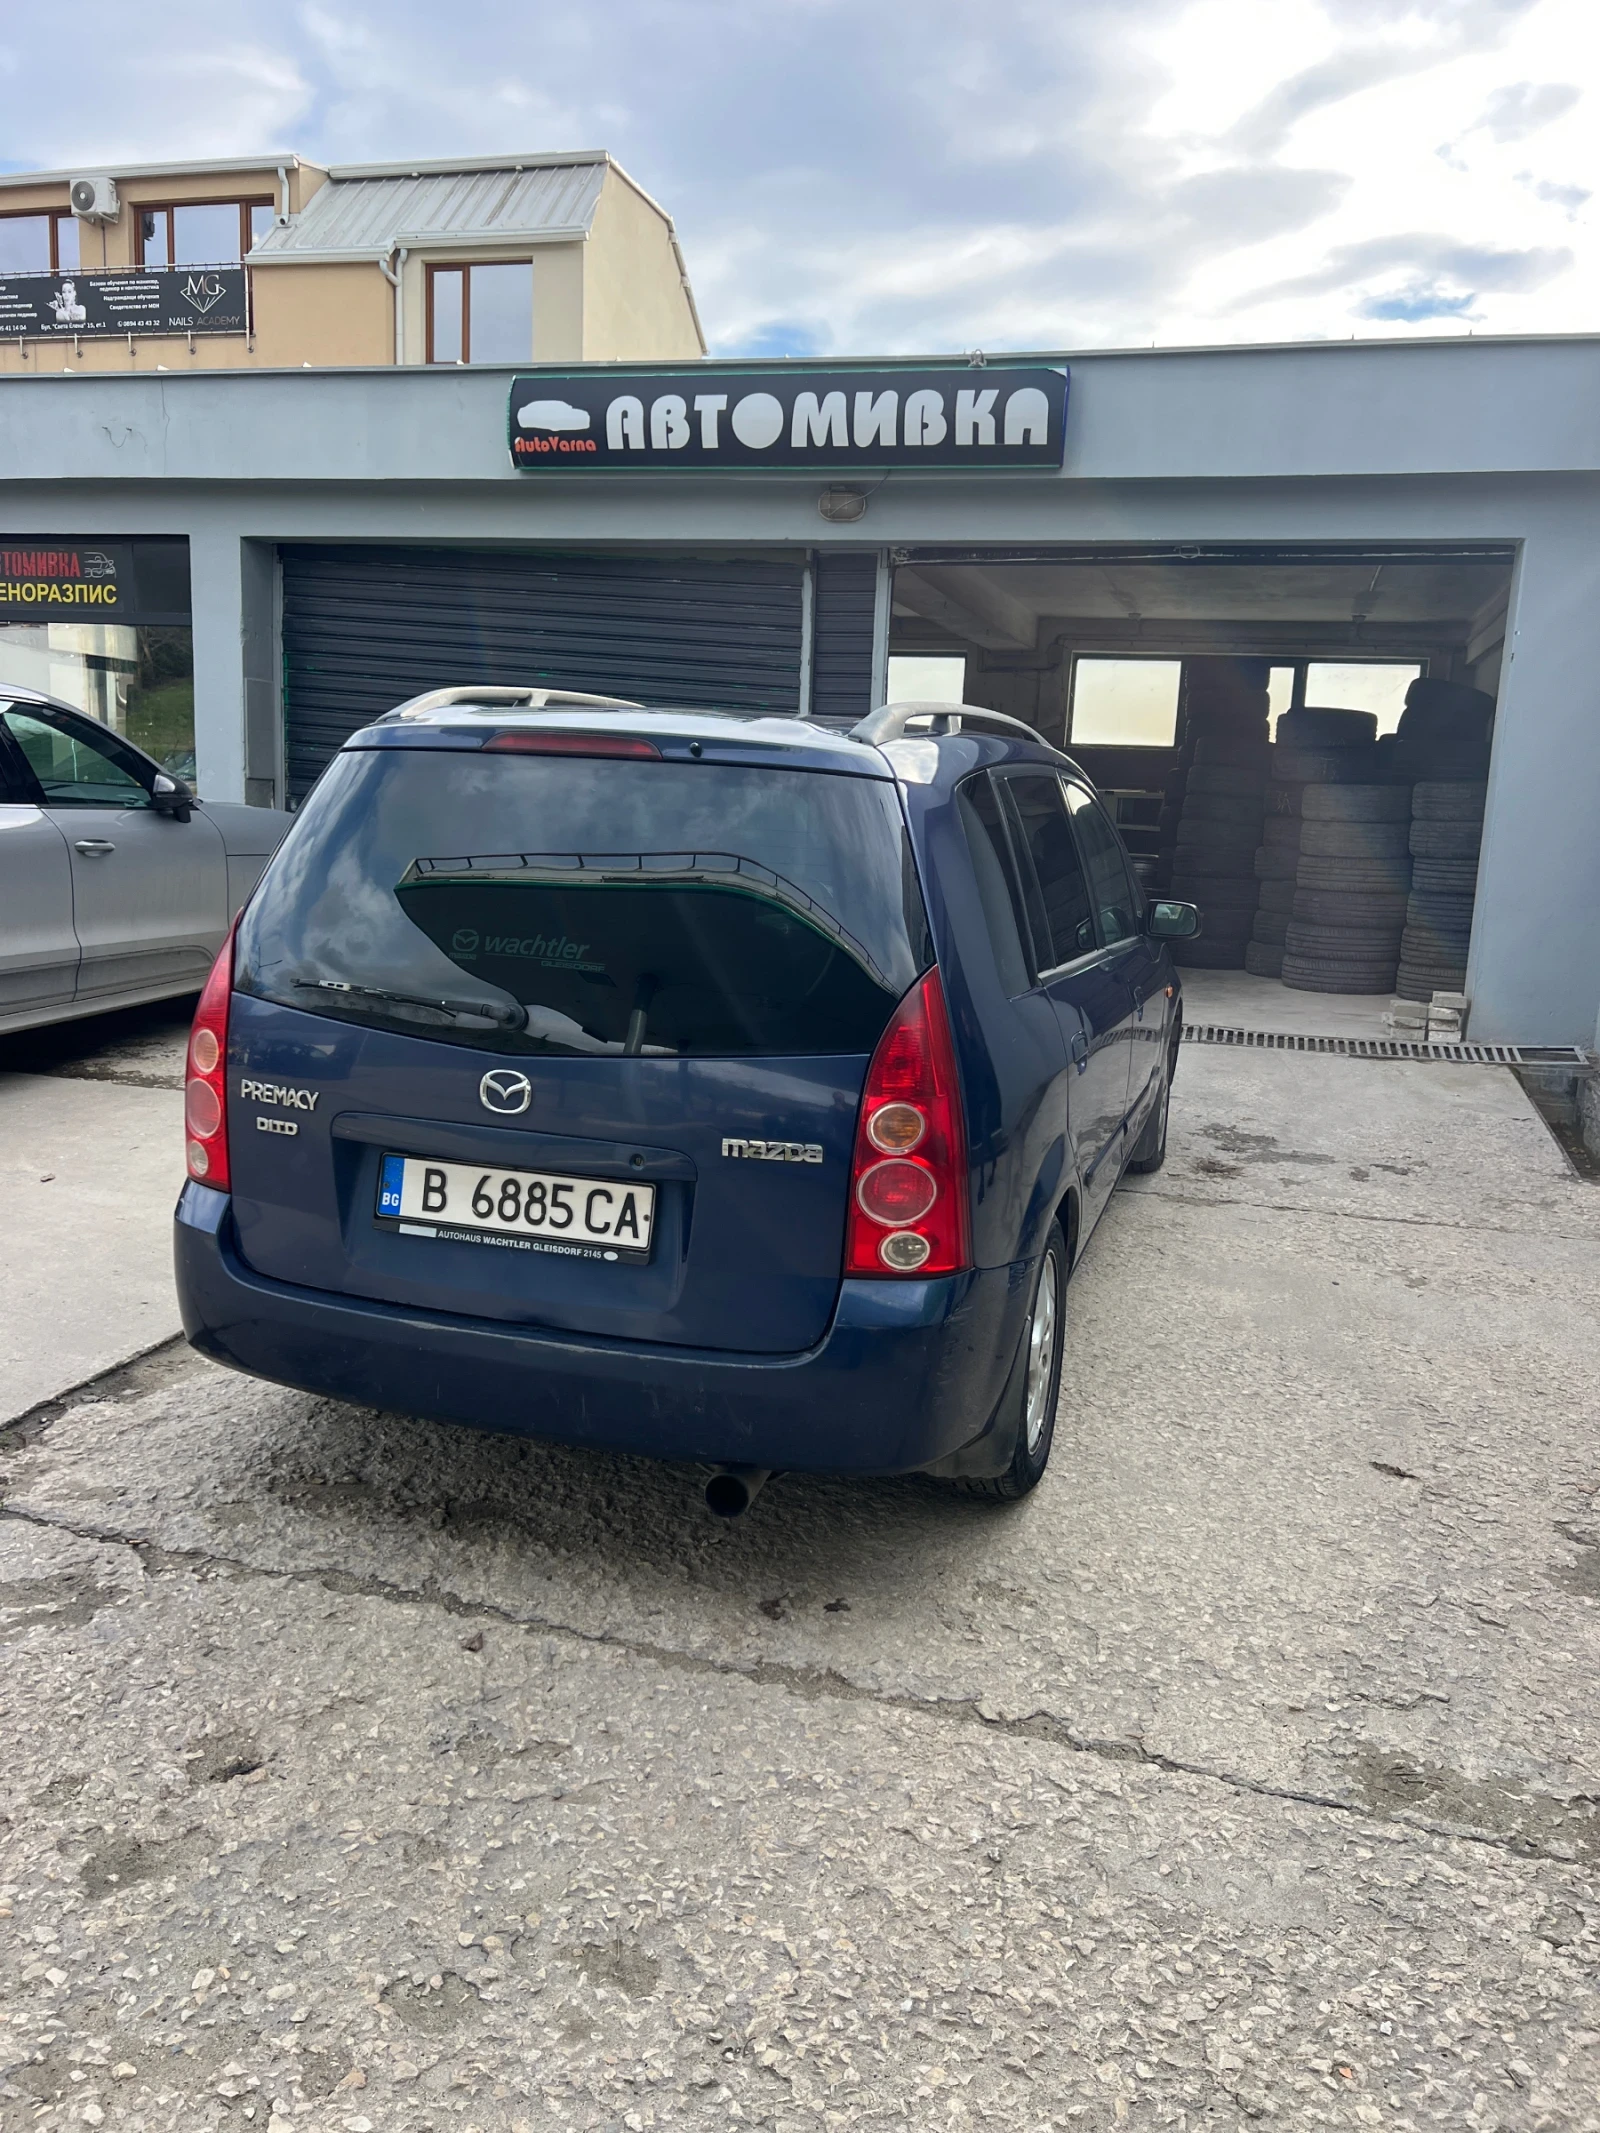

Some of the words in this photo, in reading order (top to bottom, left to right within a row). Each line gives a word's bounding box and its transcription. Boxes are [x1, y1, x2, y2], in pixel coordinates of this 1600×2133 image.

[186, 274, 220, 295] MG
[168, 317, 193, 326] NAILS
[197, 316, 240, 326] ACADEMY
[606, 387, 1049, 449] АВТОМИВКА
[514, 436, 597, 453] AutoVarna
[0, 551, 81, 577] ТОМИВКА
[0, 582, 117, 604] ЕНОРАЗПИС
[484, 933, 591, 960] wachtler
[540, 959, 607, 973] GLEISDORF
[241, 1078, 320, 1111] PREMACY
[256, 1116, 299, 1136] DITD
[721, 1137, 824, 1164] mazda
[381, 1192, 400, 1207] BG
[422, 1167, 447, 1213] B
[471, 1175, 574, 1230] 6885
[584, 1188, 640, 1239] CA
[438, 1230, 482, 1243] AUTOHAUS
[483, 1236, 531, 1250] WACHTLER
[533, 1242, 582, 1257] GLEISDORF
[583, 1249, 602, 1259] 2145
